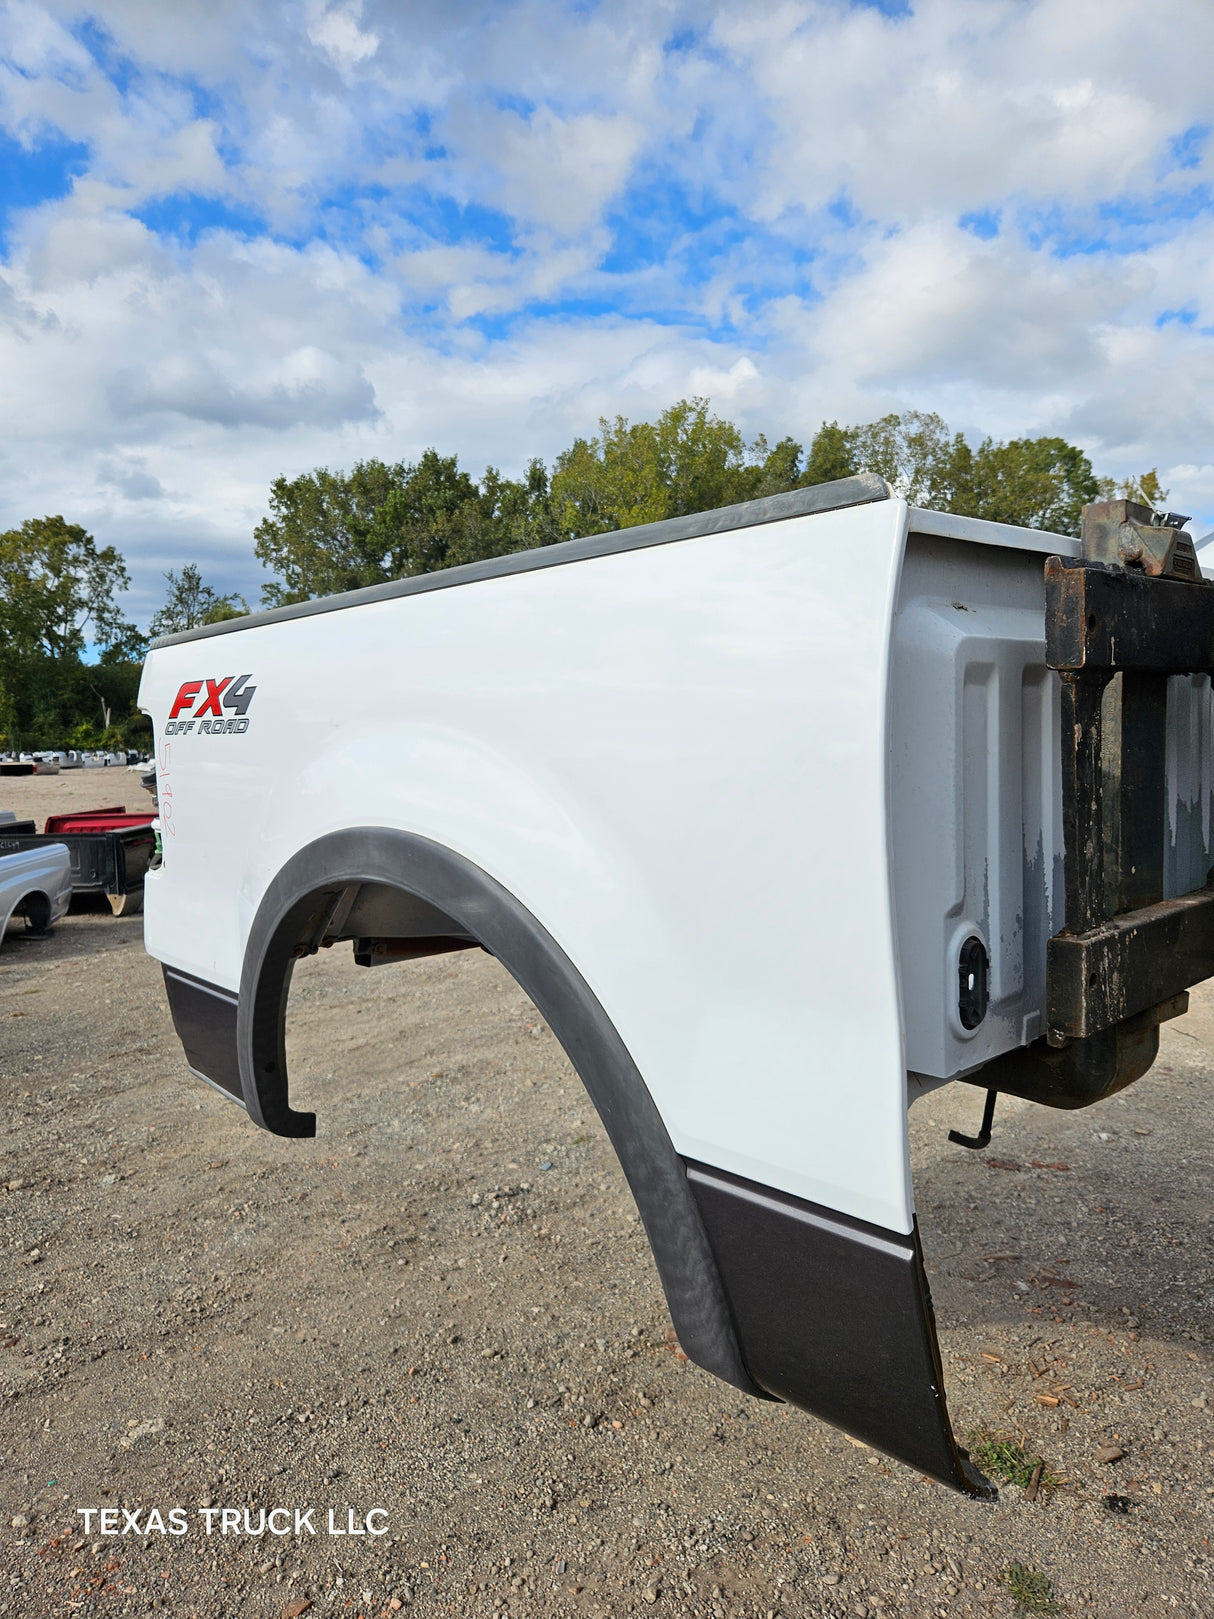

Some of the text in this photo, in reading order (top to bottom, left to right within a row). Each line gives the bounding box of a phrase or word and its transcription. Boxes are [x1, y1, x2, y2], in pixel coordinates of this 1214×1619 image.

[169, 674, 257, 719] FX4
[165, 718, 249, 735] OFF ROAD
